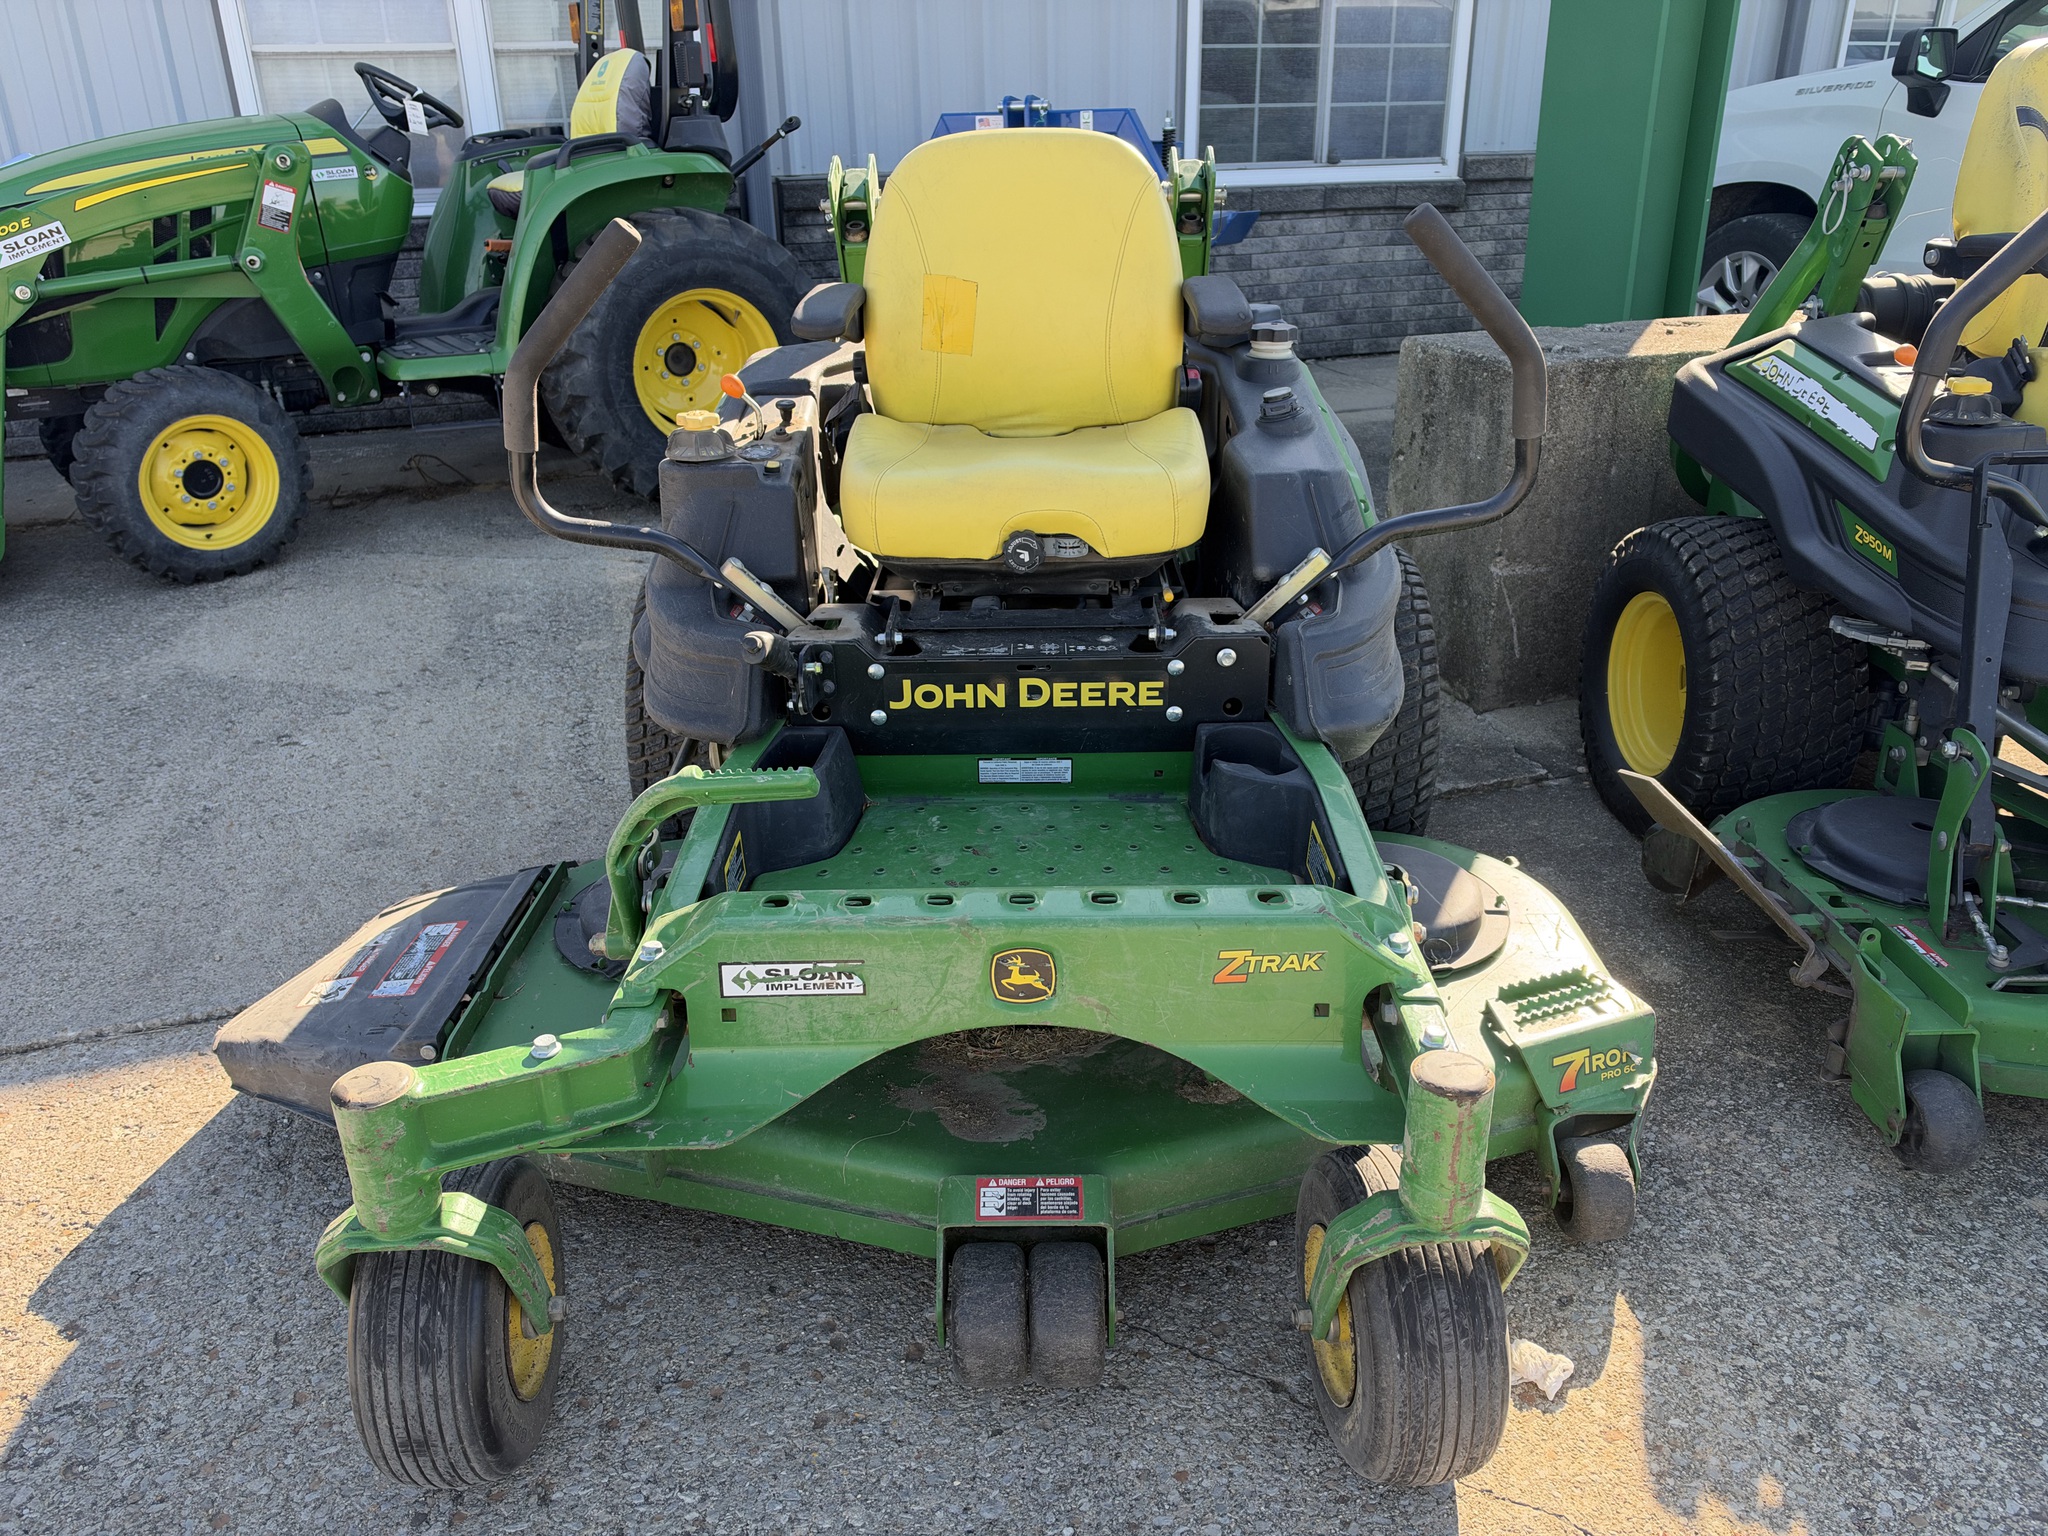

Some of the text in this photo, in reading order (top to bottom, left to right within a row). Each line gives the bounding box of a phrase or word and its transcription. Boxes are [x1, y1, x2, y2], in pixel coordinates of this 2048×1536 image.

[1795, 80, 1877, 96] SILVERADO
[325, 167, 355, 175] SLOAN
[3, 226, 62, 253] SLOAN
[8, 236, 65, 260] IMPLEMENT
[1762, 359, 1795, 387] JOHN
[1855, 524, 1892, 562] Z950M
[889, 677, 1164, 710] JOHN DEERE
[765, 968, 854, 981] SLOAN
[766, 982, 854, 991] IMPLEMENT
[1601, 1068, 1622, 1081] PRO
[1045, 1178, 1075, 1186] PELIGRO
